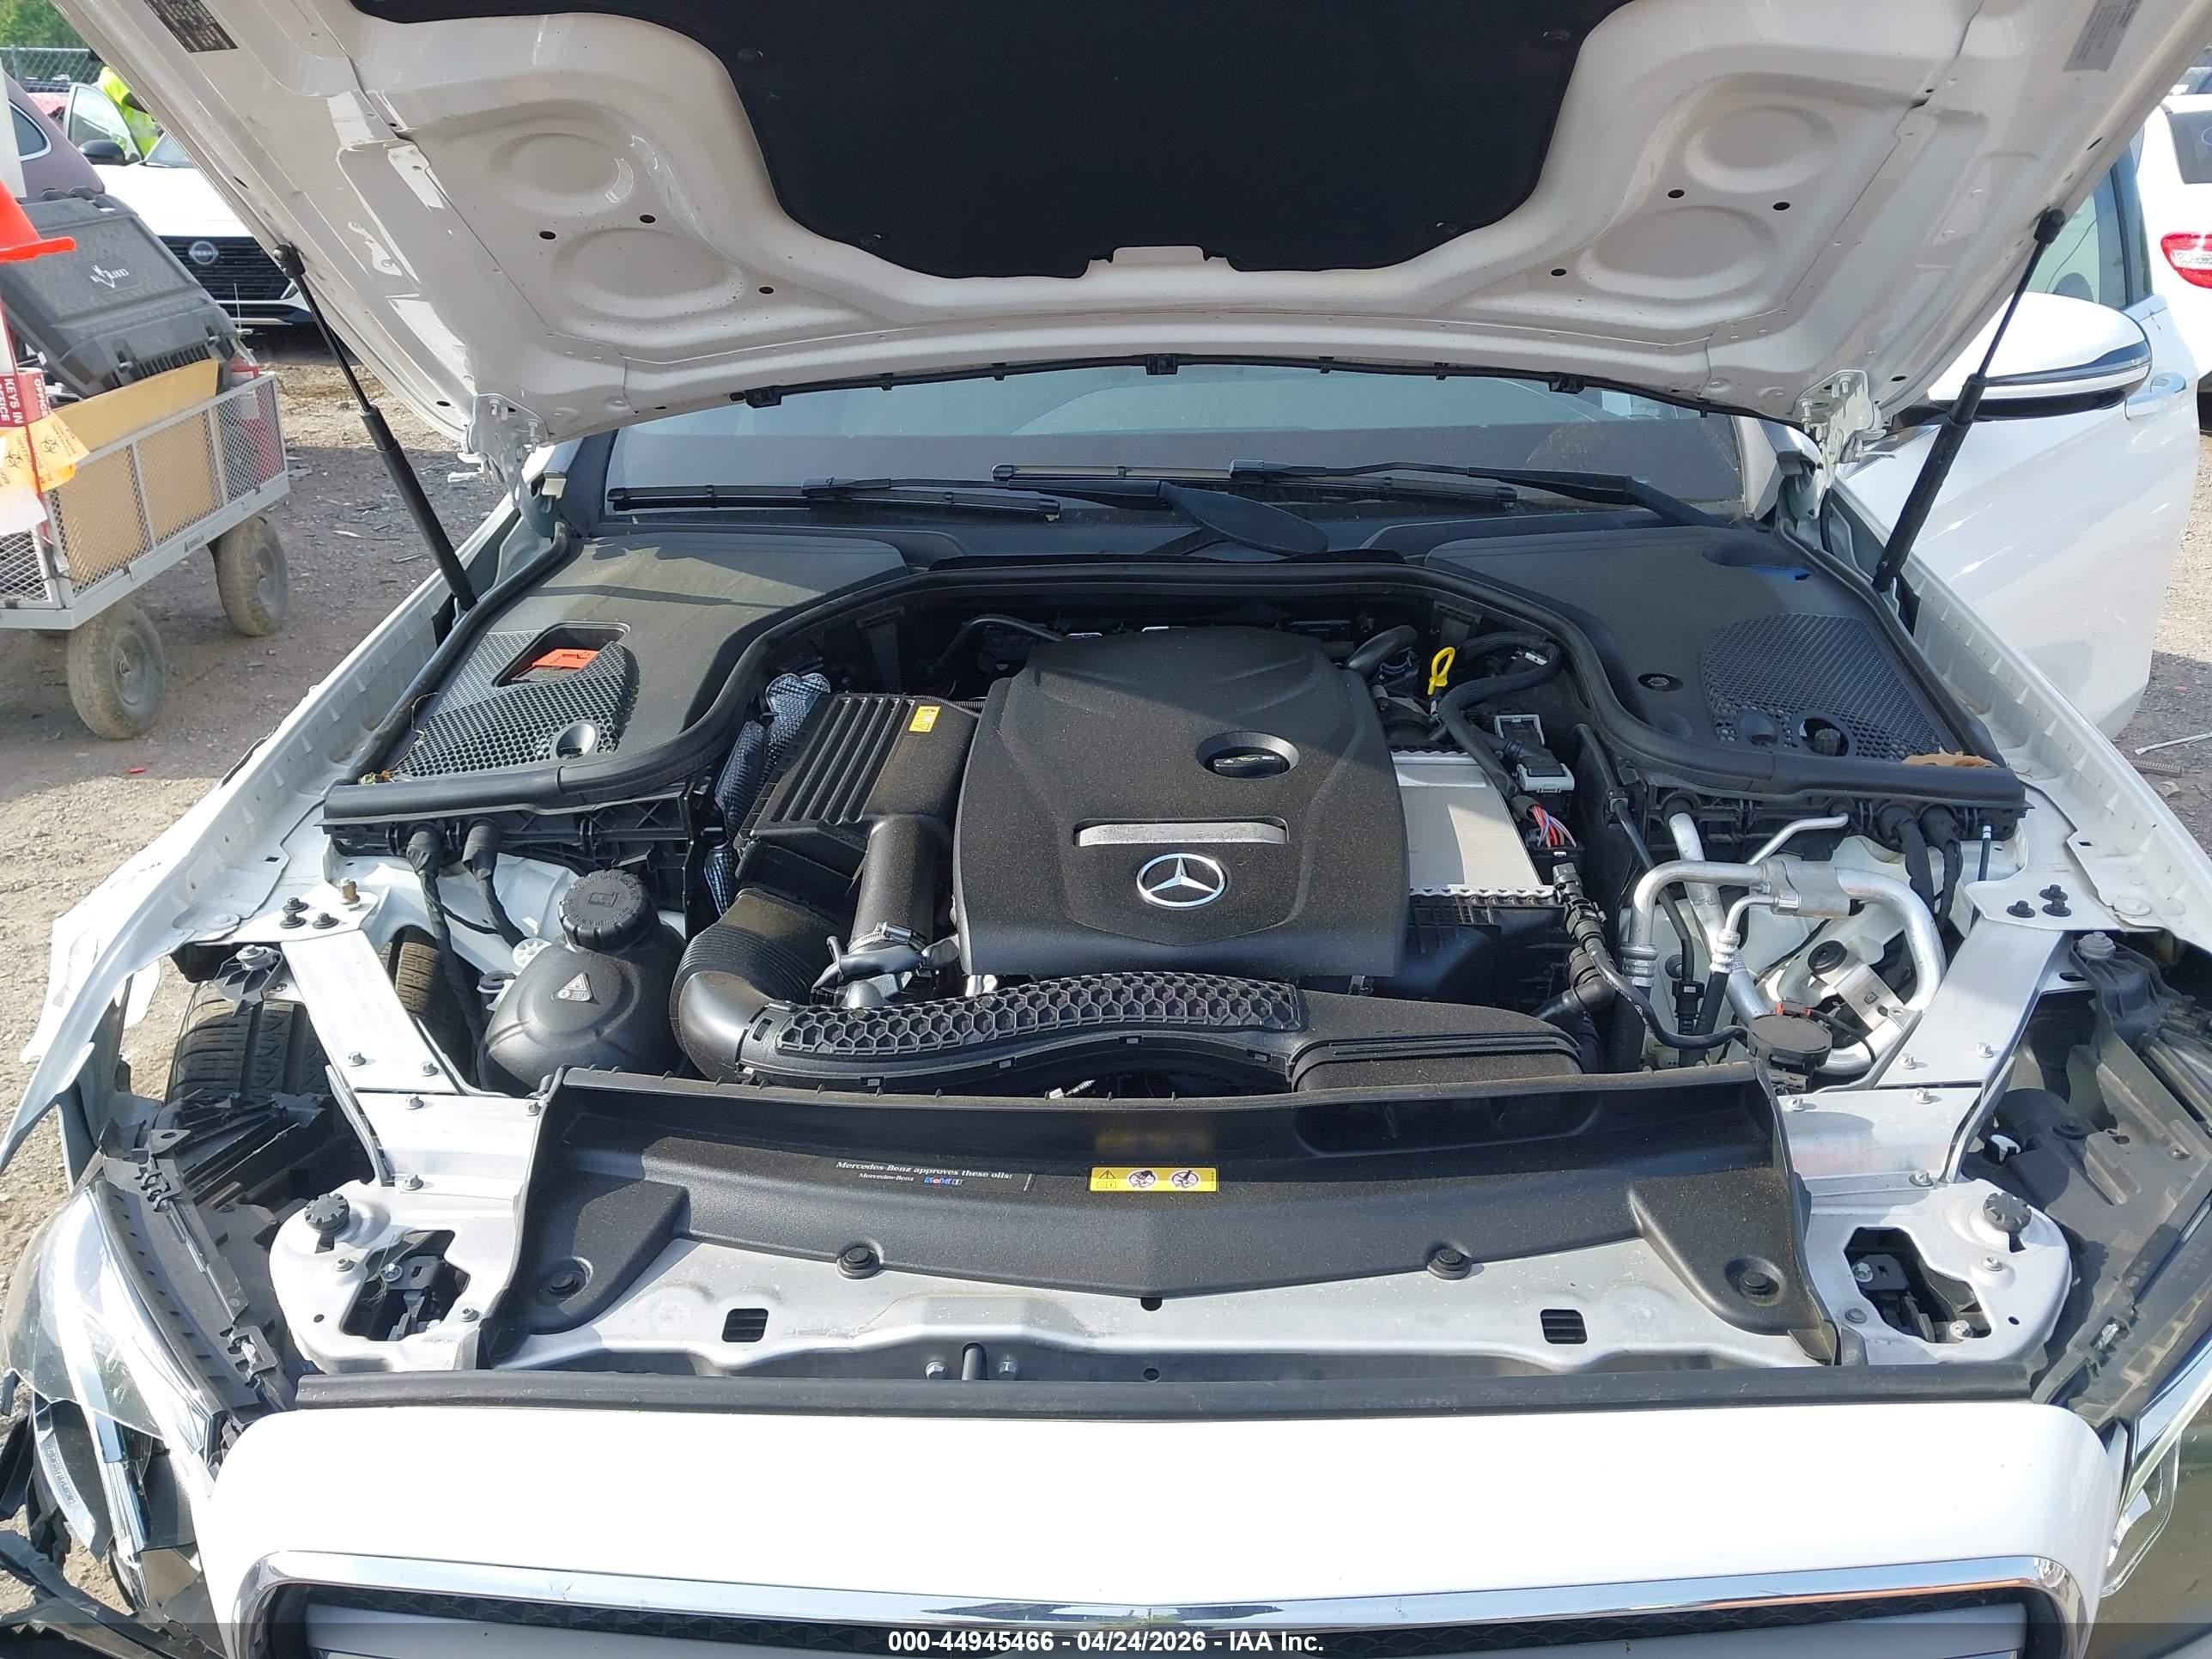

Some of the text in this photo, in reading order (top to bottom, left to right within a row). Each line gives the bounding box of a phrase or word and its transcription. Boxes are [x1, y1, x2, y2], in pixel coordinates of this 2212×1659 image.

[0, 383, 10, 422] FFICE
[4, 379, 24, 424] KEYS IN
[836, 1161, 911, 1173] Mercedes-Benz
[913, 1166, 958, 1176] approves
[961, 1170, 988, 1178] these
